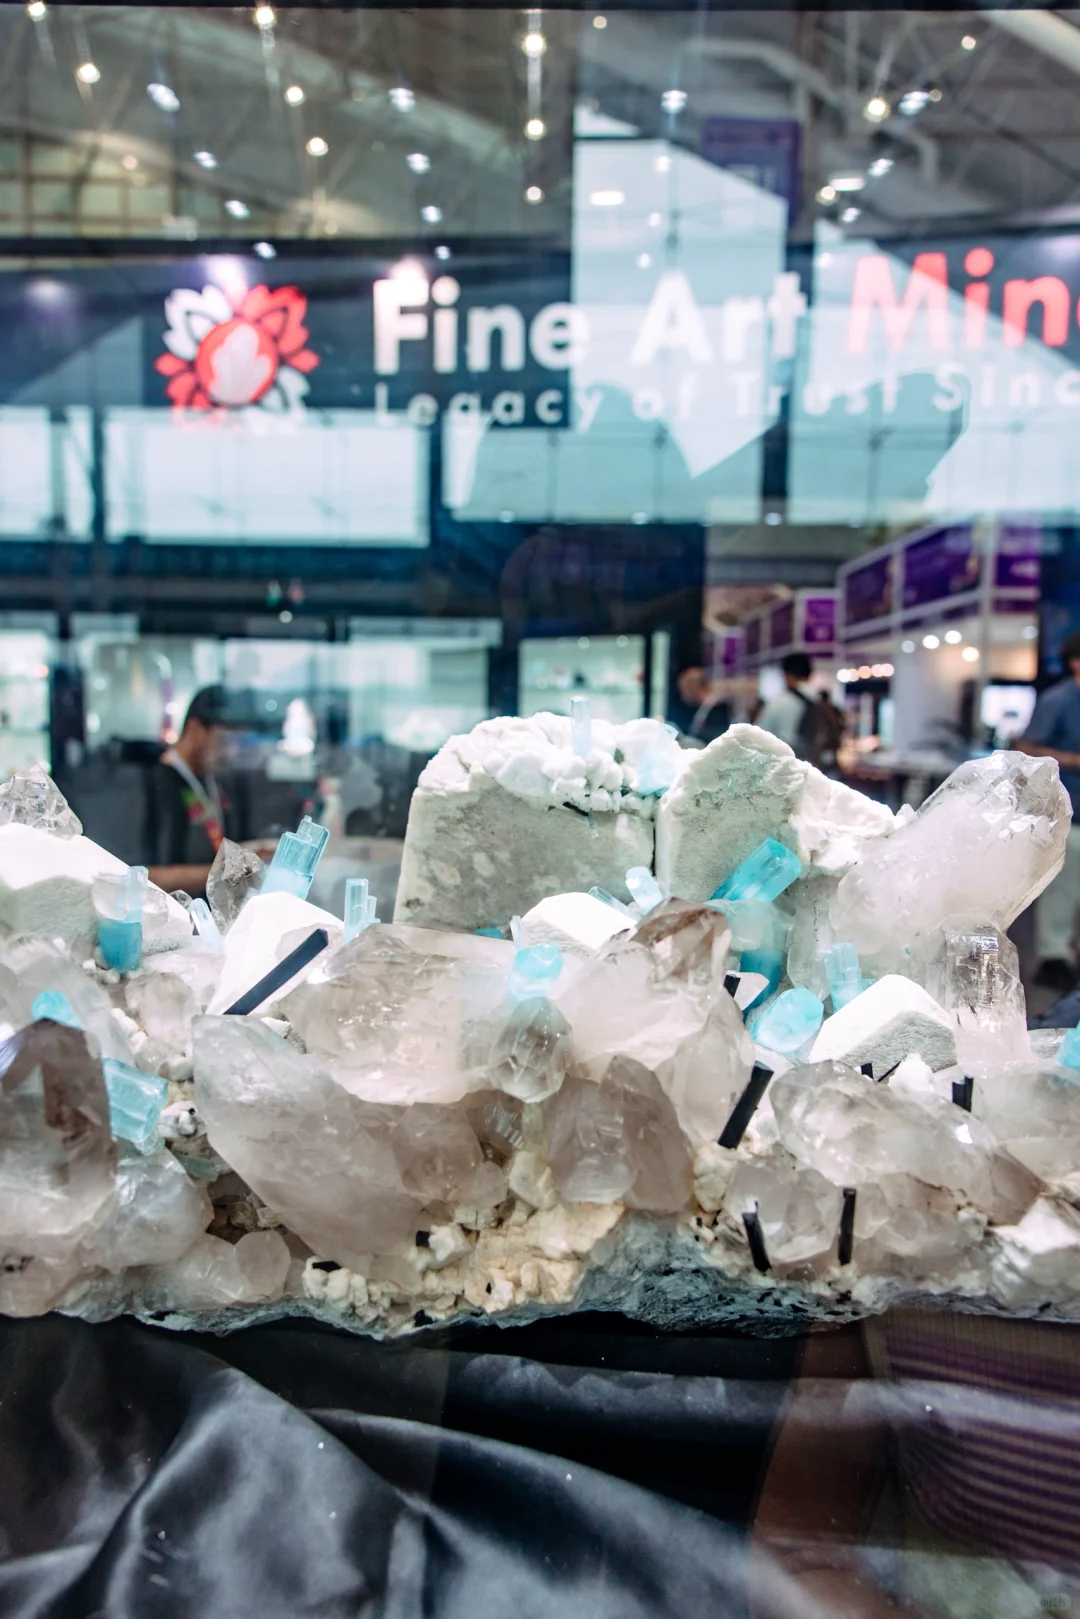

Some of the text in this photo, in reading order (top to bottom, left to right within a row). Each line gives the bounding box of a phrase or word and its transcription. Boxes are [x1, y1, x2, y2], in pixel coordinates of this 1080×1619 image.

[373, 246, 1080, 374] Fine Art Min
[374, 381, 602, 434] Legacy
[631, 370, 701, 422] of
[731, 365, 901, 416] Trust
